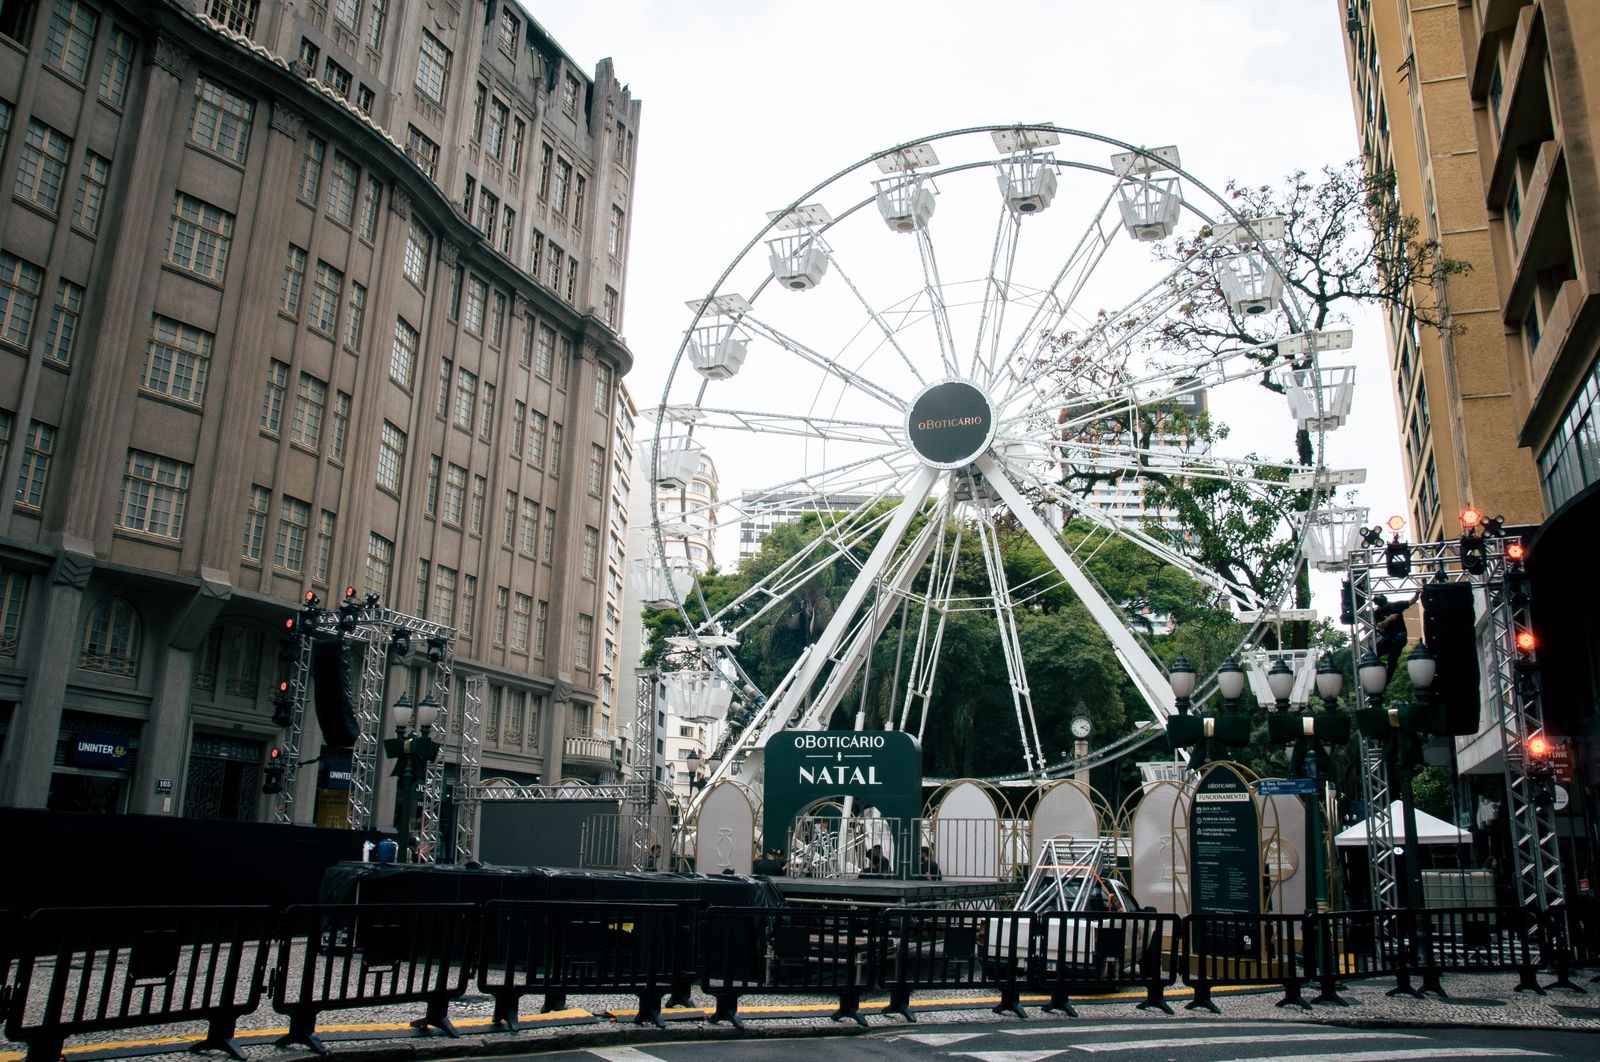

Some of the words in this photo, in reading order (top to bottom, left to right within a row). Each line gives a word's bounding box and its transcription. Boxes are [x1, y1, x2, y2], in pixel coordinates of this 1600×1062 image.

[78, 741, 114, 755] UNINTER
[330, 771, 351, 780] UNINTE
[799, 765, 883, 785] NATAL
